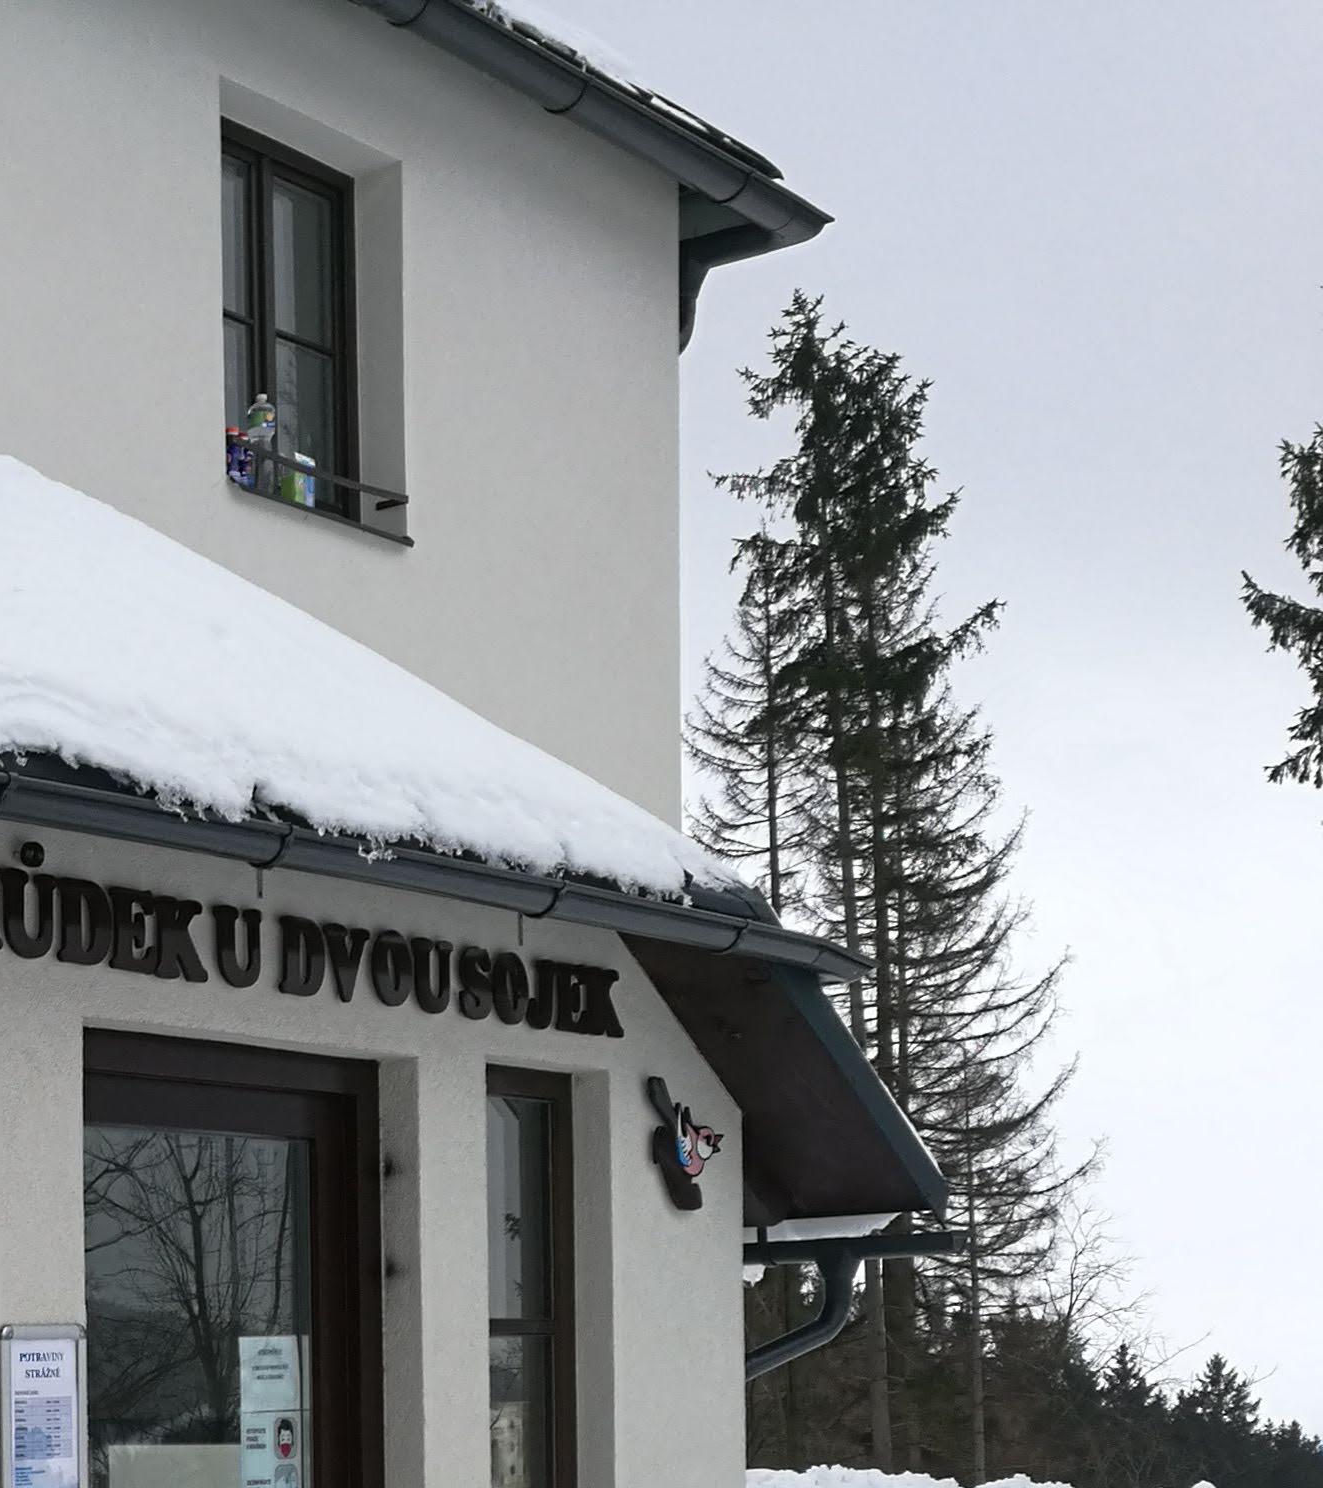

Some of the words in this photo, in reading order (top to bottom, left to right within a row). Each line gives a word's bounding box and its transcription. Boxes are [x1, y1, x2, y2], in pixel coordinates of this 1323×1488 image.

[212, 903, 262, 990] U
[279, 915, 455, 1014] DVOU
[458, 943, 625, 1039] SOJEK
[19, 1351, 64, 1362] POTRAVINY
